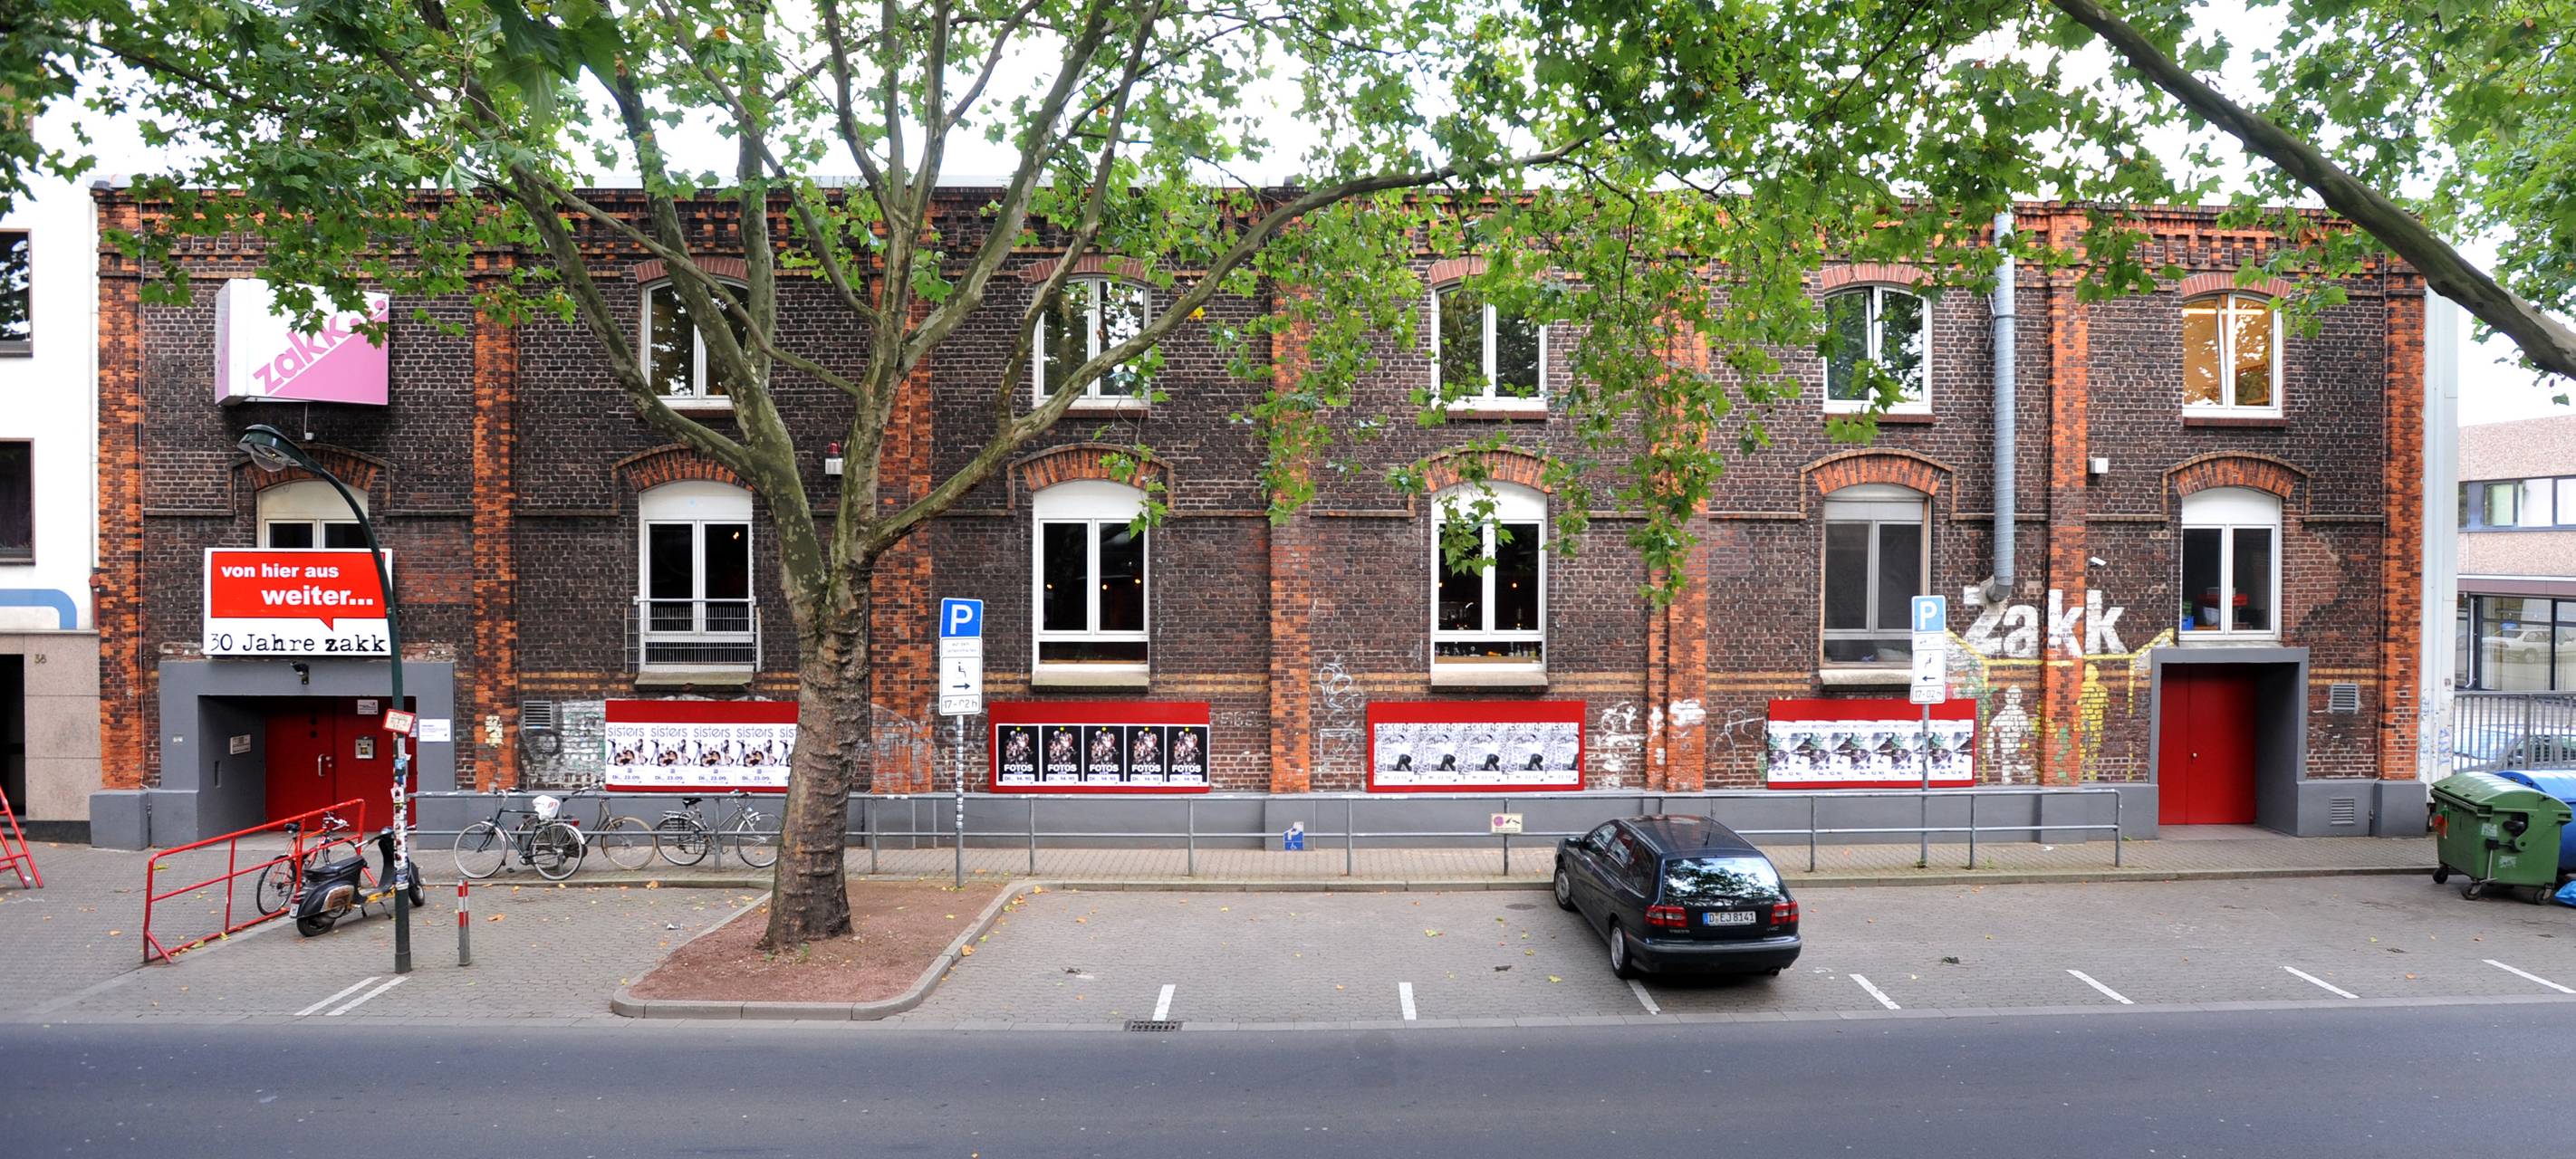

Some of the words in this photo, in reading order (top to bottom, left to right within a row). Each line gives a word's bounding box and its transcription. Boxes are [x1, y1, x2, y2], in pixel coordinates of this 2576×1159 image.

[221, 566, 255, 578] von
[261, 563, 299, 578] hier
[304, 566, 340, 578] aus
[261, 585, 373, 606] weiter...
[950, 604, 973, 635] P
[1919, 600, 1937, 630] P
[210, 634, 233, 651] 30
[243, 634, 315, 652] Jahre
[325, 634, 386, 652] zakk
[608, 725, 644, 737] sisters
[650, 725, 687, 737] sisters
[694, 726, 730, 738] sisters
[736, 726, 774, 738] sisters
[1131, 764, 1161, 772] FOTOS
[1709, 915, 1715, 923] D
